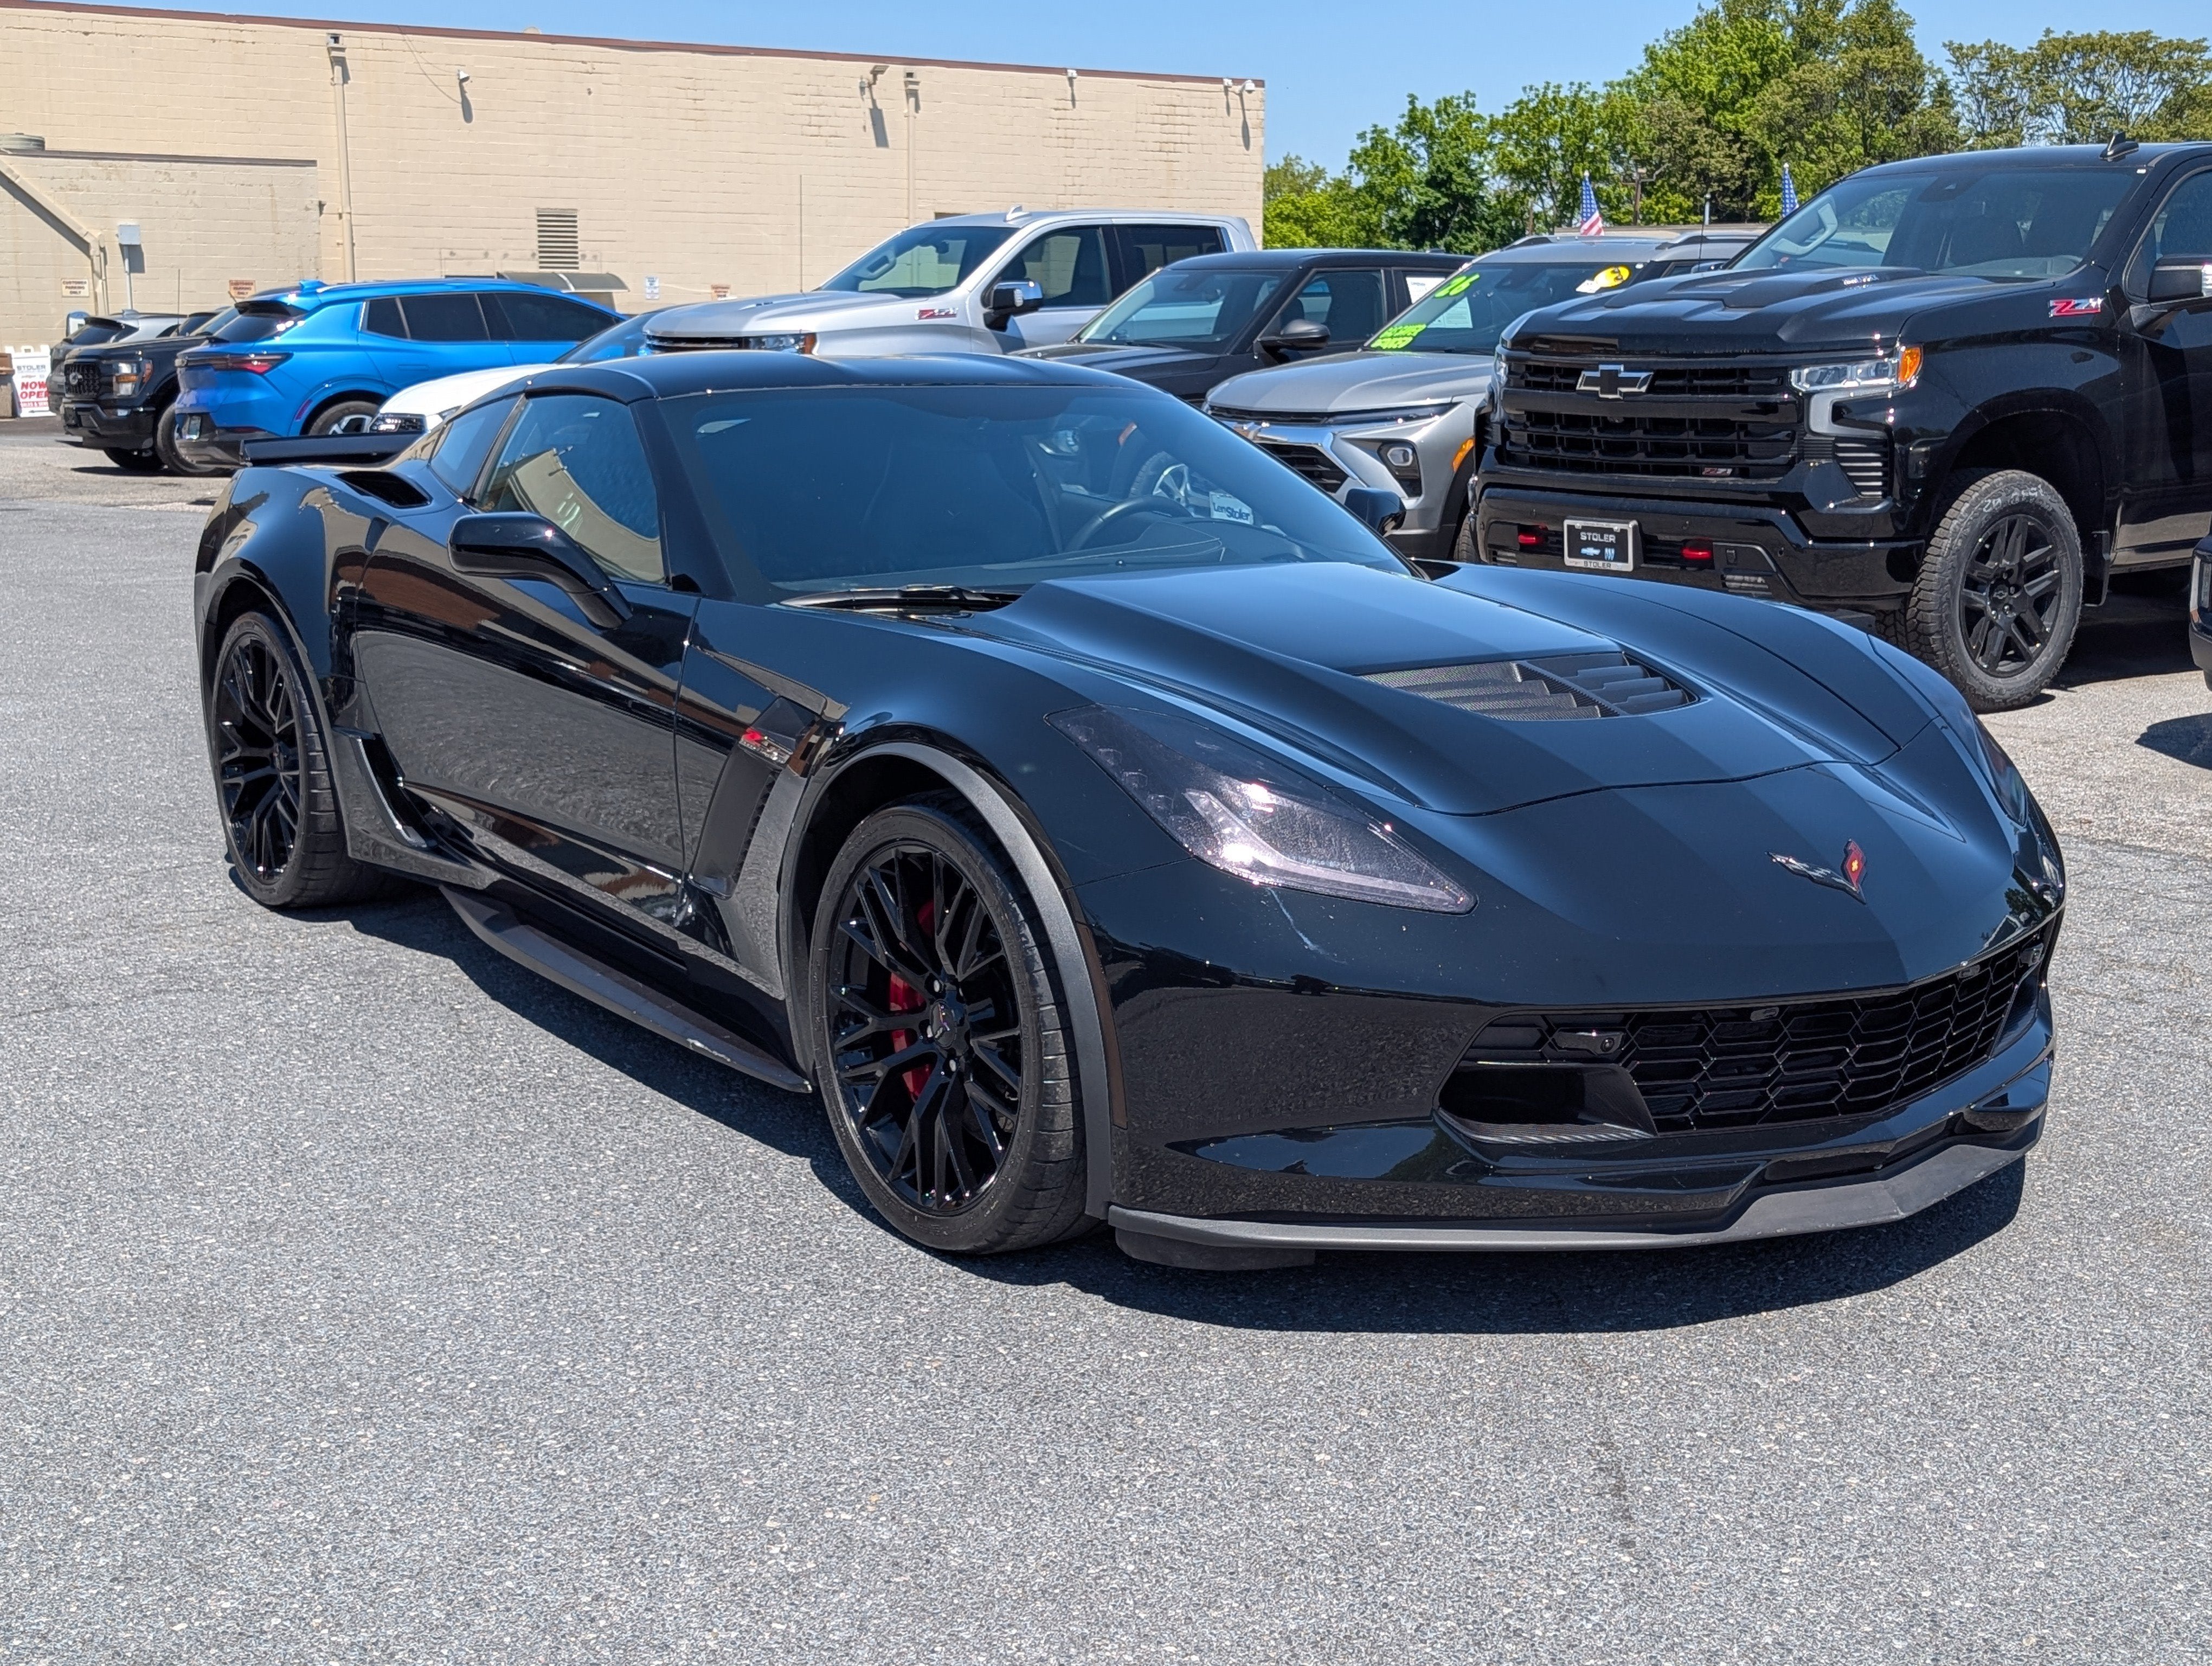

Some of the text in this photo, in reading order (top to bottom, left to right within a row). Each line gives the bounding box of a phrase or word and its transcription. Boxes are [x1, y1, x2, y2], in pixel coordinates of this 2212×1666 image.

[2049, 298, 2102, 317] Z71
[21, 381, 47, 390] NOW
[1580, 531, 1616, 543] STOLER
